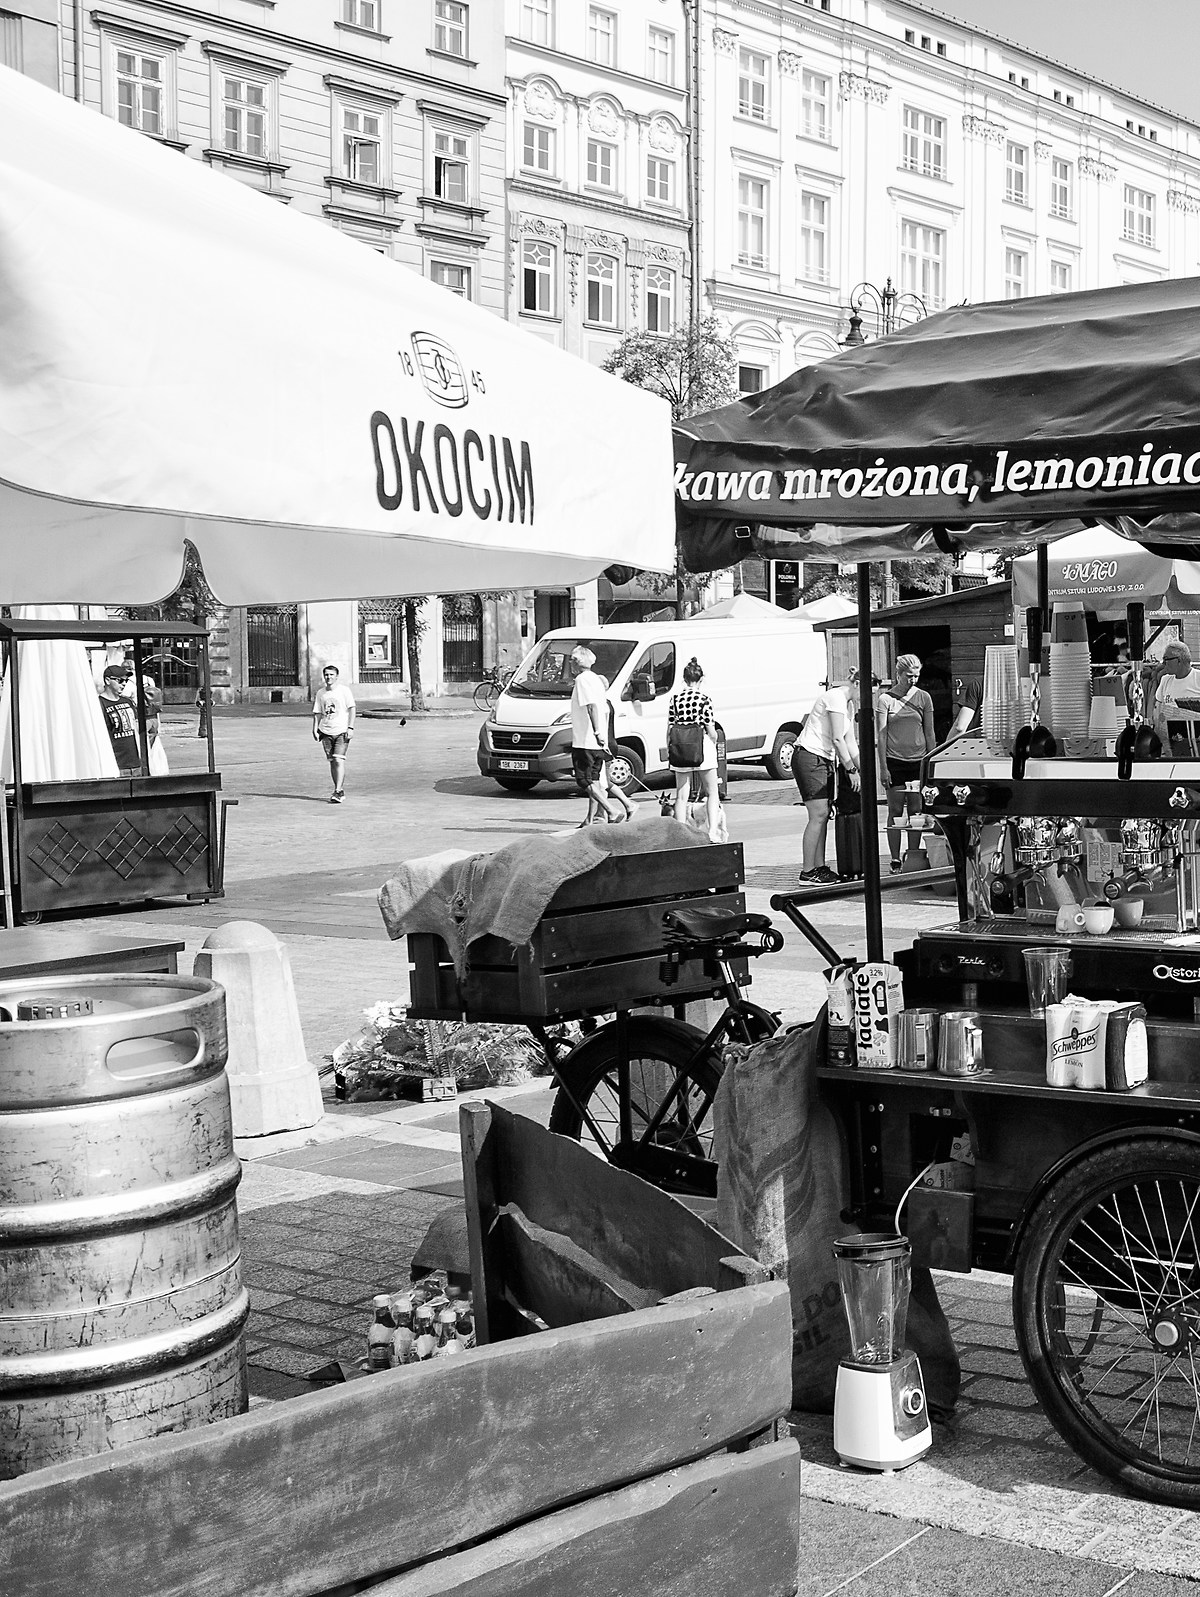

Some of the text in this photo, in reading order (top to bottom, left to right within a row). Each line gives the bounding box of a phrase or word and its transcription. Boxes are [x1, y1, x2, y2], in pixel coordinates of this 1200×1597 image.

[398, 350, 486, 394] 18 45
[370, 410, 535, 526] OKOCIM
[673, 461, 772, 501] kawa
[779, 457, 980, 503] mrożona,
[1061, 559, 1119, 583] IMAGO
[1087, 585, 1116, 594] LUDOWEJ
[855, 973, 873, 1050] łaciate
[1052, 1033, 1096, 1055] Schweppes
